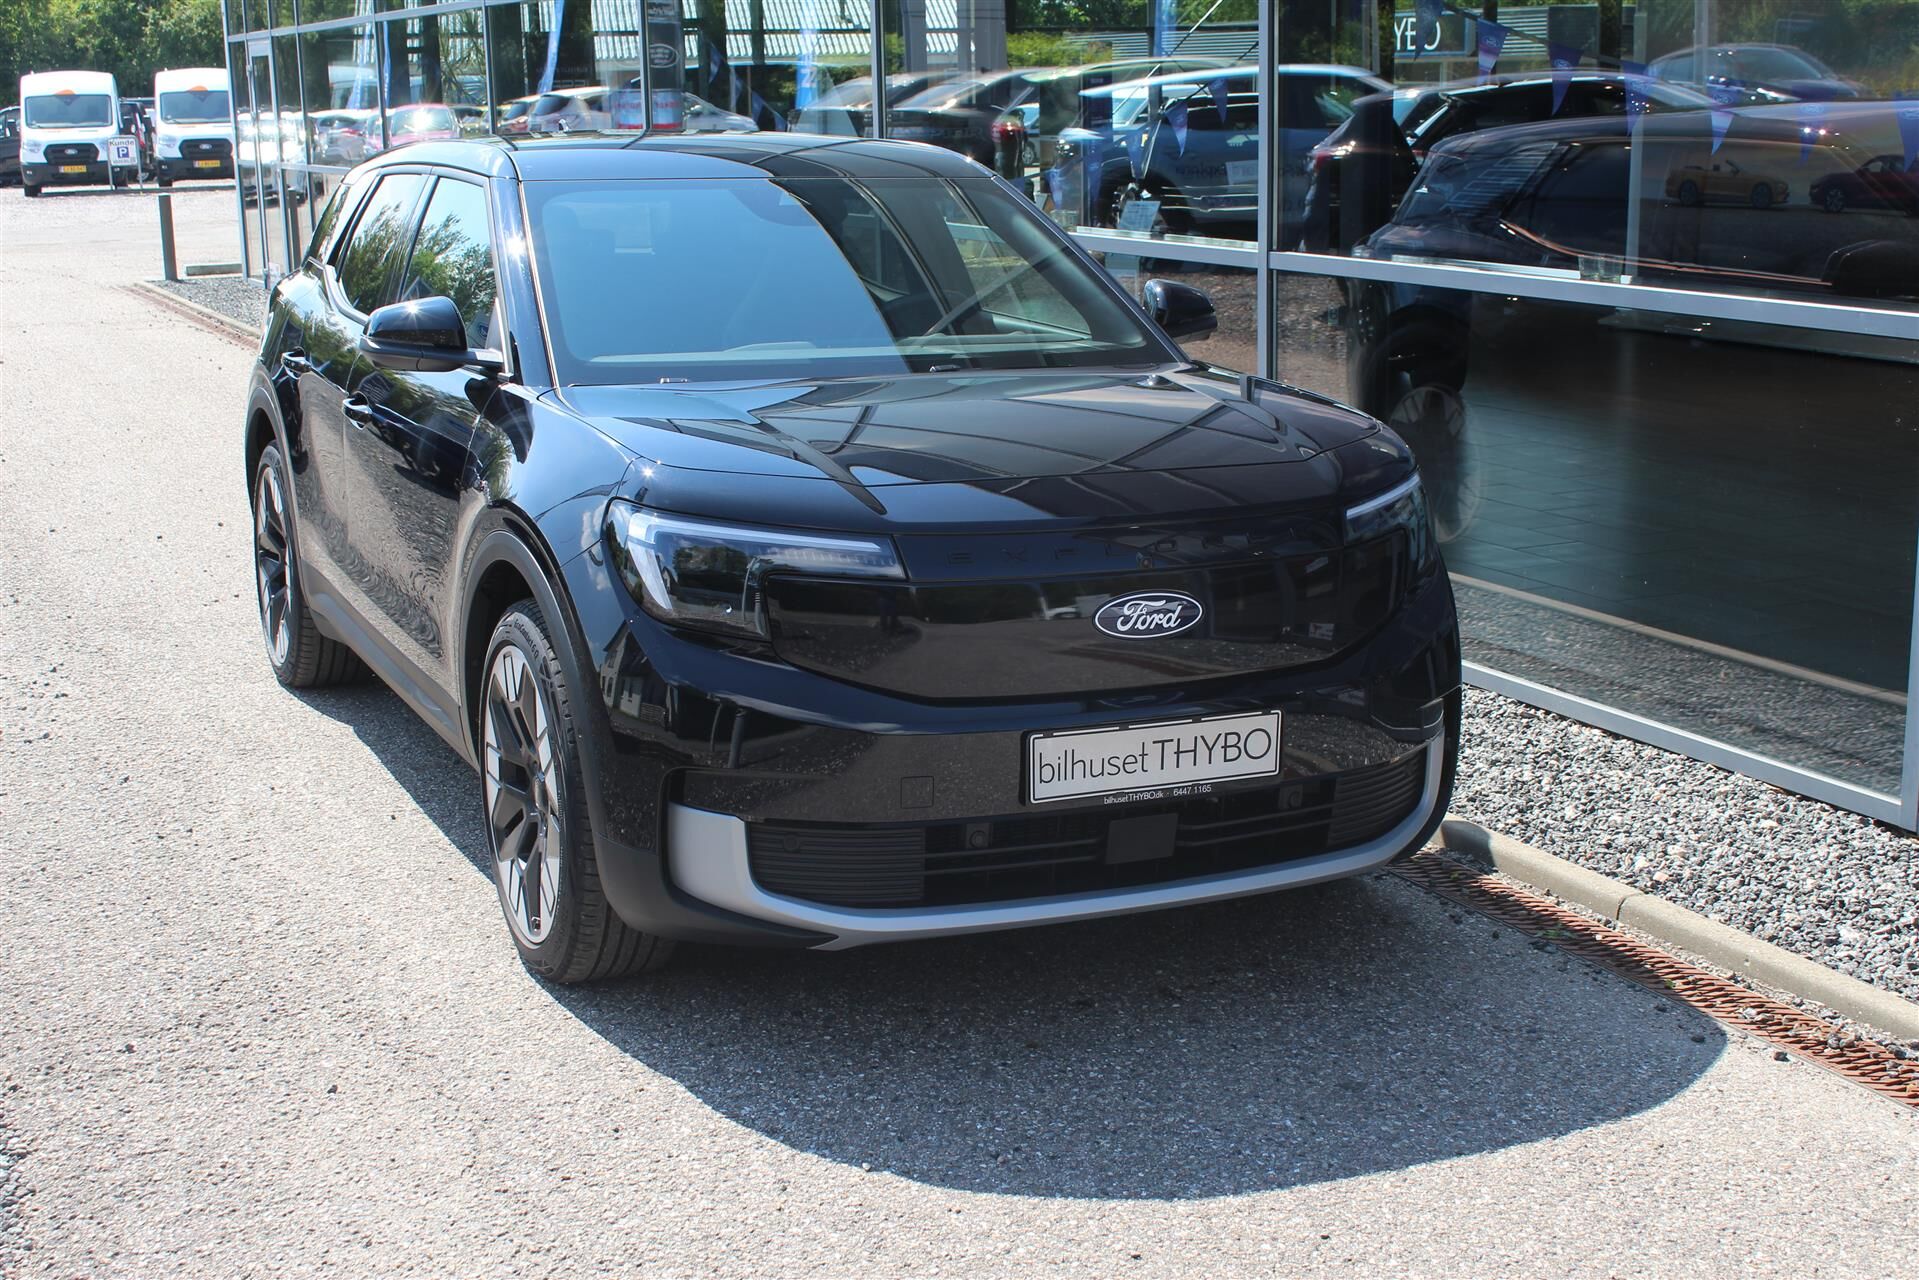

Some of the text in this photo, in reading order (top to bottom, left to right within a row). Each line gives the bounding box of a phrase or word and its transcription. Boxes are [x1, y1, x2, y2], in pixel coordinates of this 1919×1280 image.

[119, 147, 128, 158] P
[1116, 599, 1183, 632] Ford
[1173, 786, 1192, 797] 6447
[1194, 784, 1212, 795] 1165
